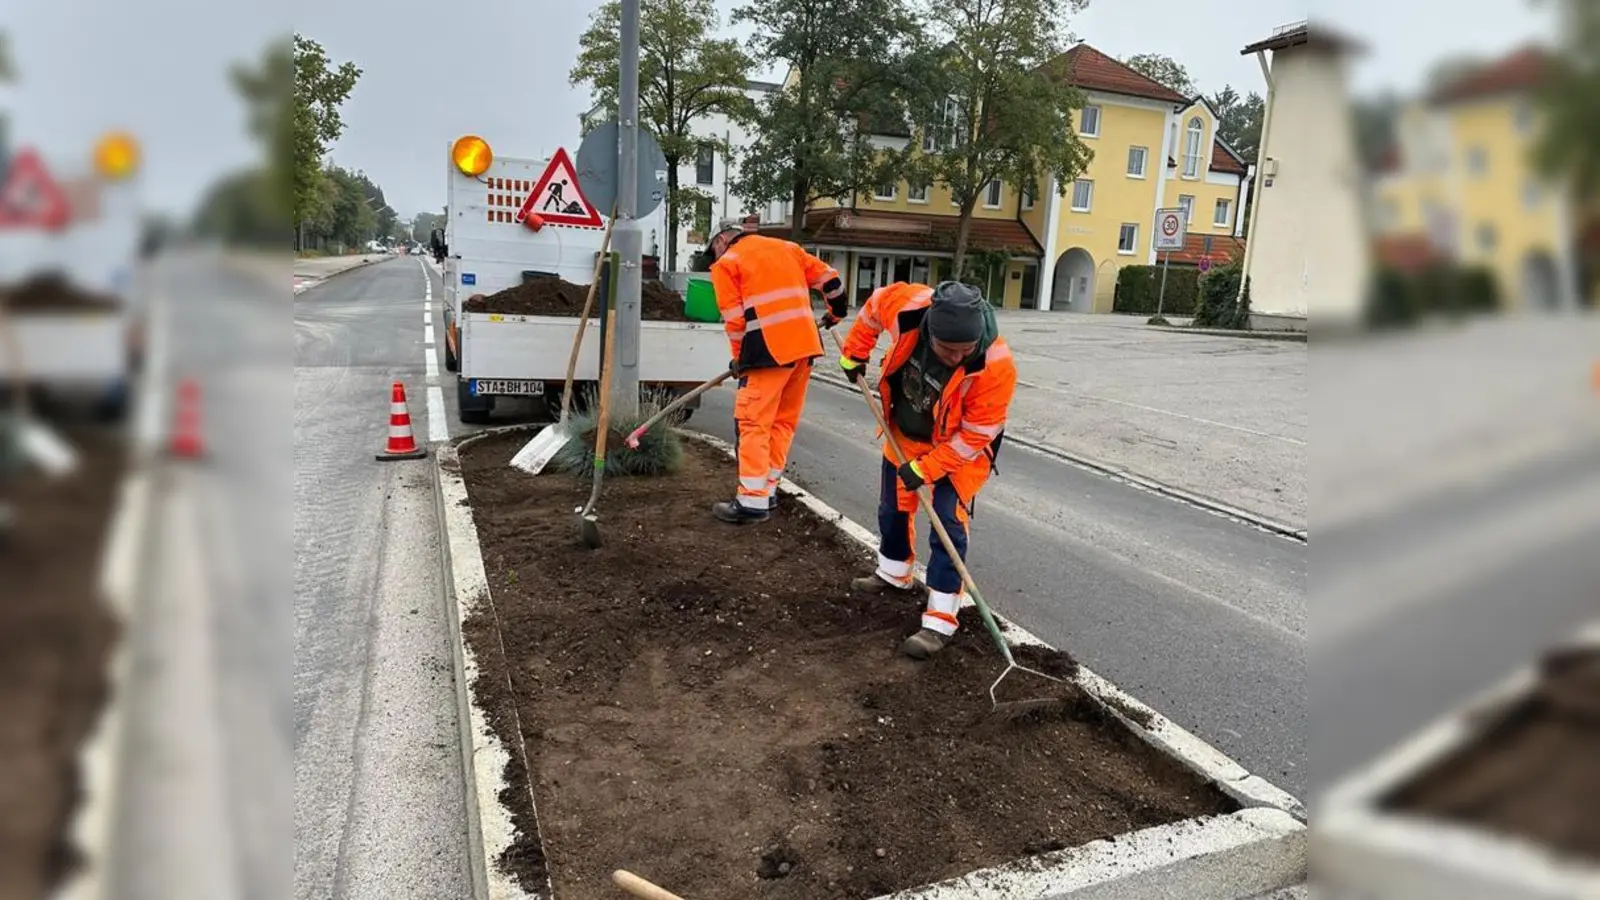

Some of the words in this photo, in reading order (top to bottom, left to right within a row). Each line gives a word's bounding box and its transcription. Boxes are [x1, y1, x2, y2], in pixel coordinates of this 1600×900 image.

[1165, 220, 1176, 230] 30
[478, 381, 498, 392] STA
[507, 382, 521, 393] BH
[523, 382, 543, 393] 104
